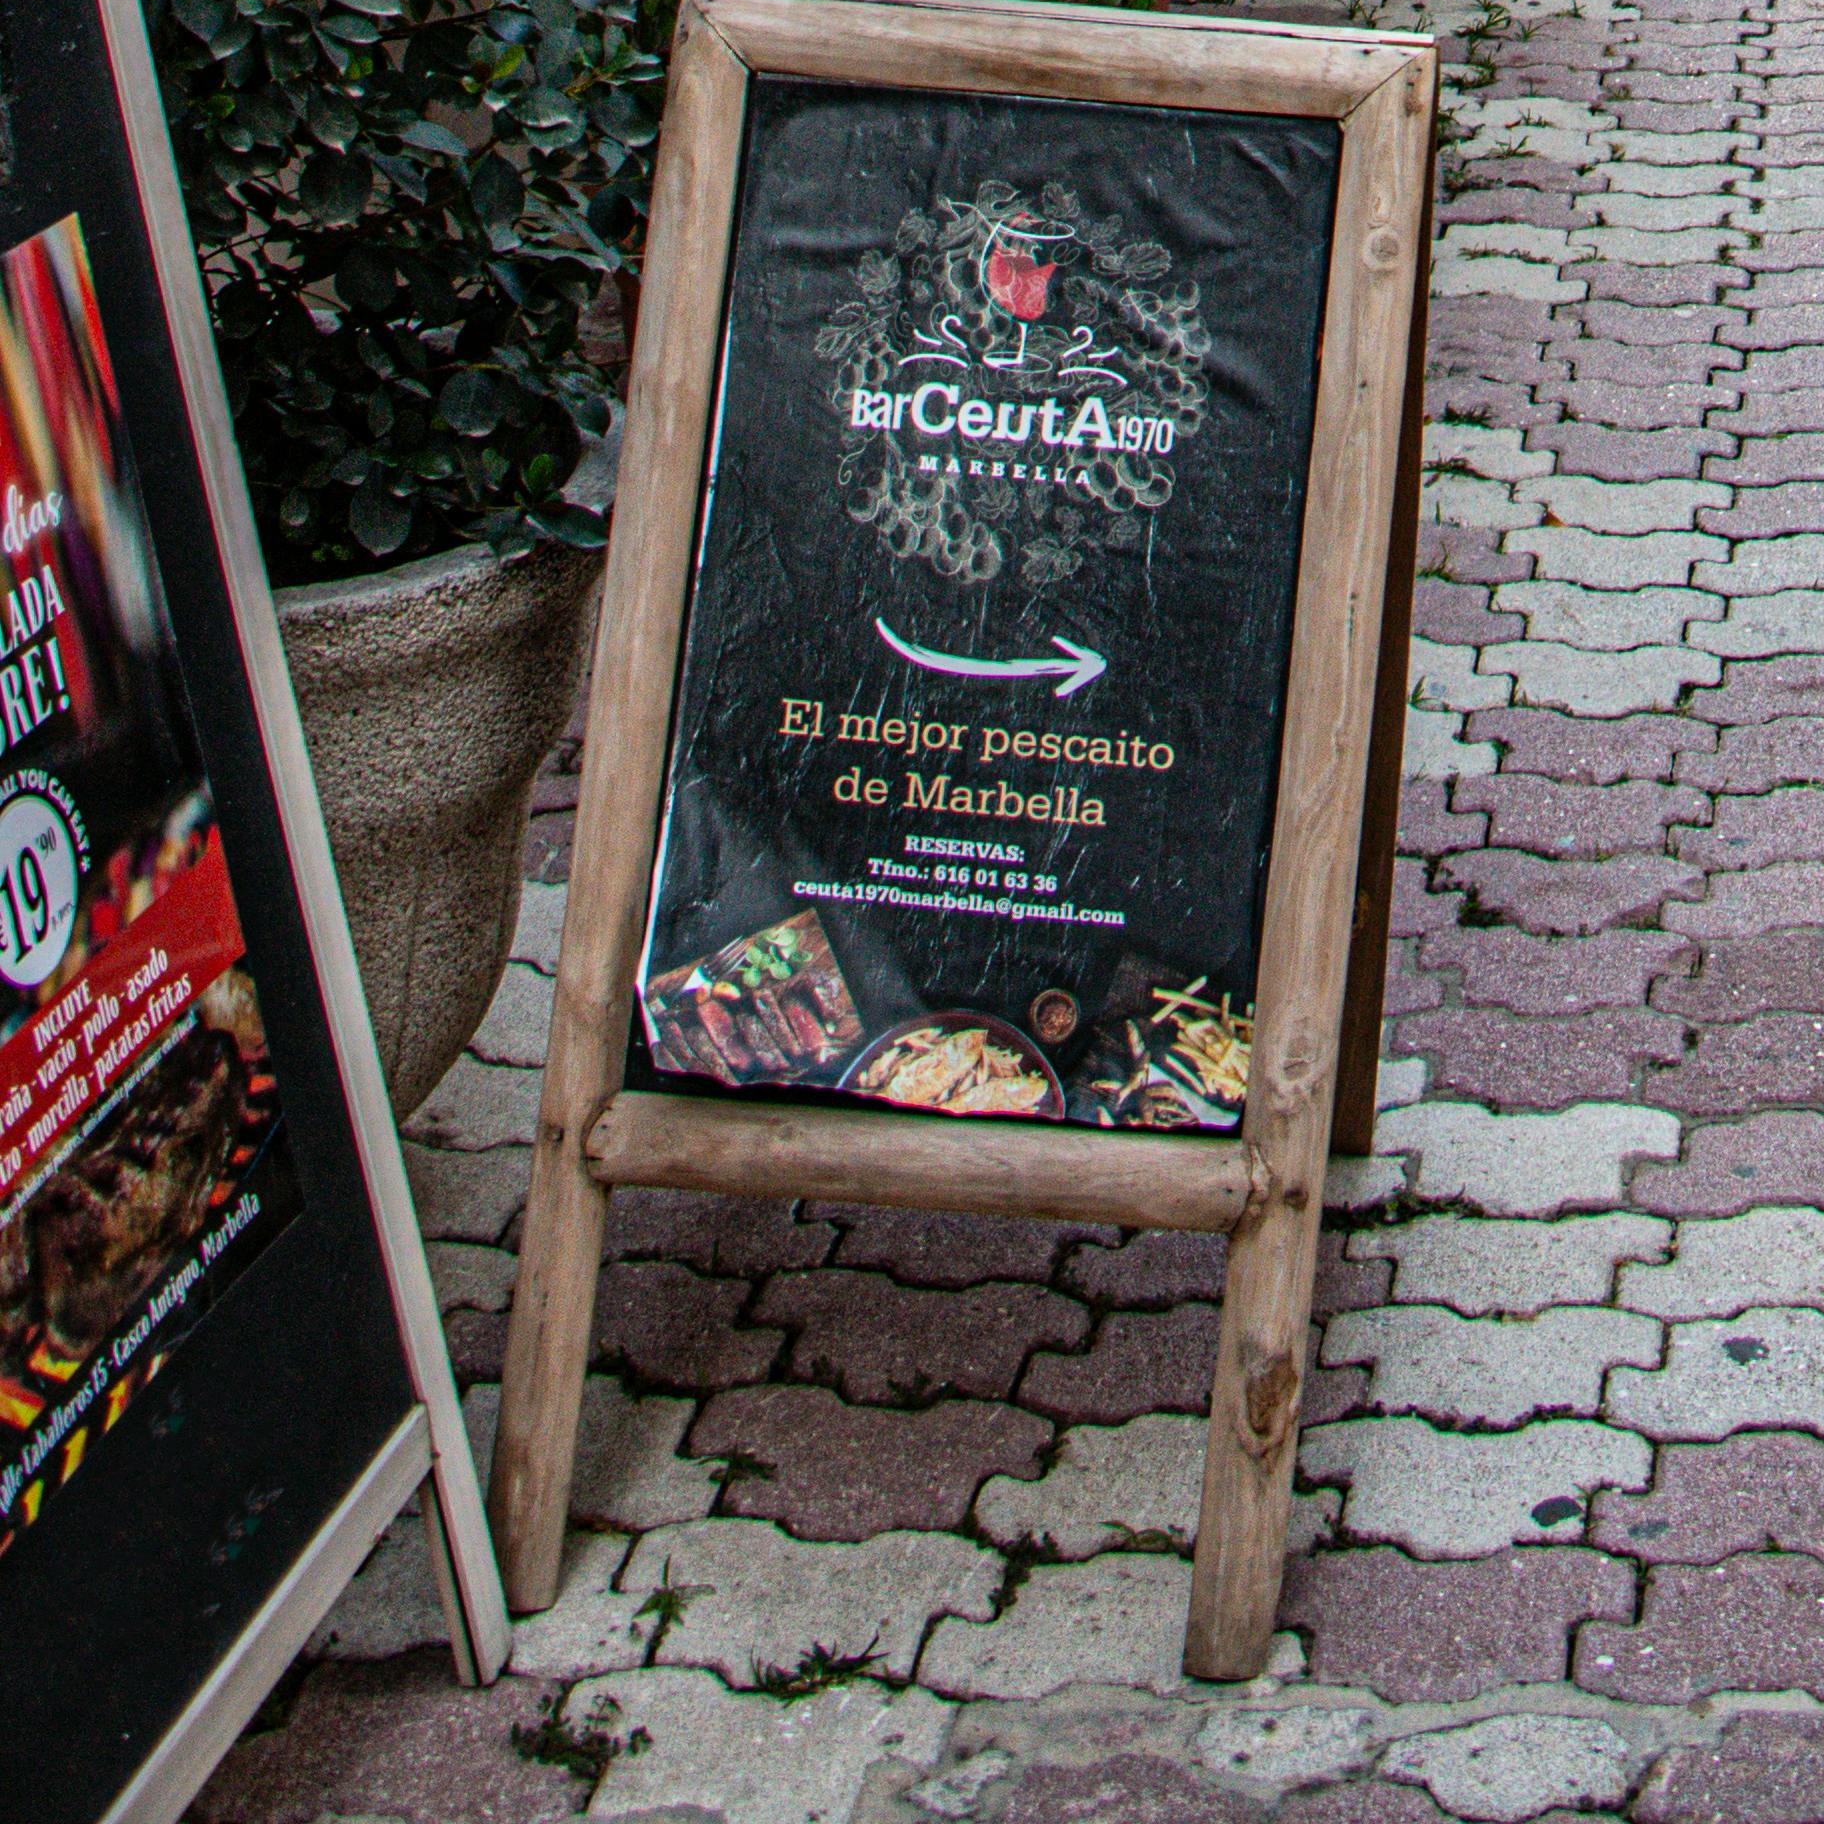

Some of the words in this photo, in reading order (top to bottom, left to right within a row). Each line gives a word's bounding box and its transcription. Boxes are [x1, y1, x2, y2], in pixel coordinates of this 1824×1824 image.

[919, 454, 1091, 485] MARBELLA
[779, 698, 824, 737] El
[838, 711, 969, 755] mejor
[979, 727, 1175, 771] pescaito
[18, 768, 48, 790] YOU
[834, 766, 888, 805] de
[902, 772, 1106, 826] Marbella
[868, 857, 929, 881] Tfno.:
[934, 864, 970, 885] 616
[975, 868, 999, 887] 01
[1003, 871, 1029, 891] 63
[1033, 874, 1058, 894] 36
[904, 834, 1025, 863] RESERVAS:
[793, 879, 1126, 926] ceuta1970marbella@gmail.com
[31, 979, 93, 1052] INCLUYE
[82, 992, 120, 1054] pollo
[125, 947, 168, 1003] asado
[27, 1073, 90, 1152] morcilla
[94, 1013, 151, 1093] patatas
[148, 972, 192, 1030] fritas
[21, 1380, 95, 1475] Caballeros
[112, 1313, 151, 1368] Casco
[200, 1192, 262, 1267] Marbella
